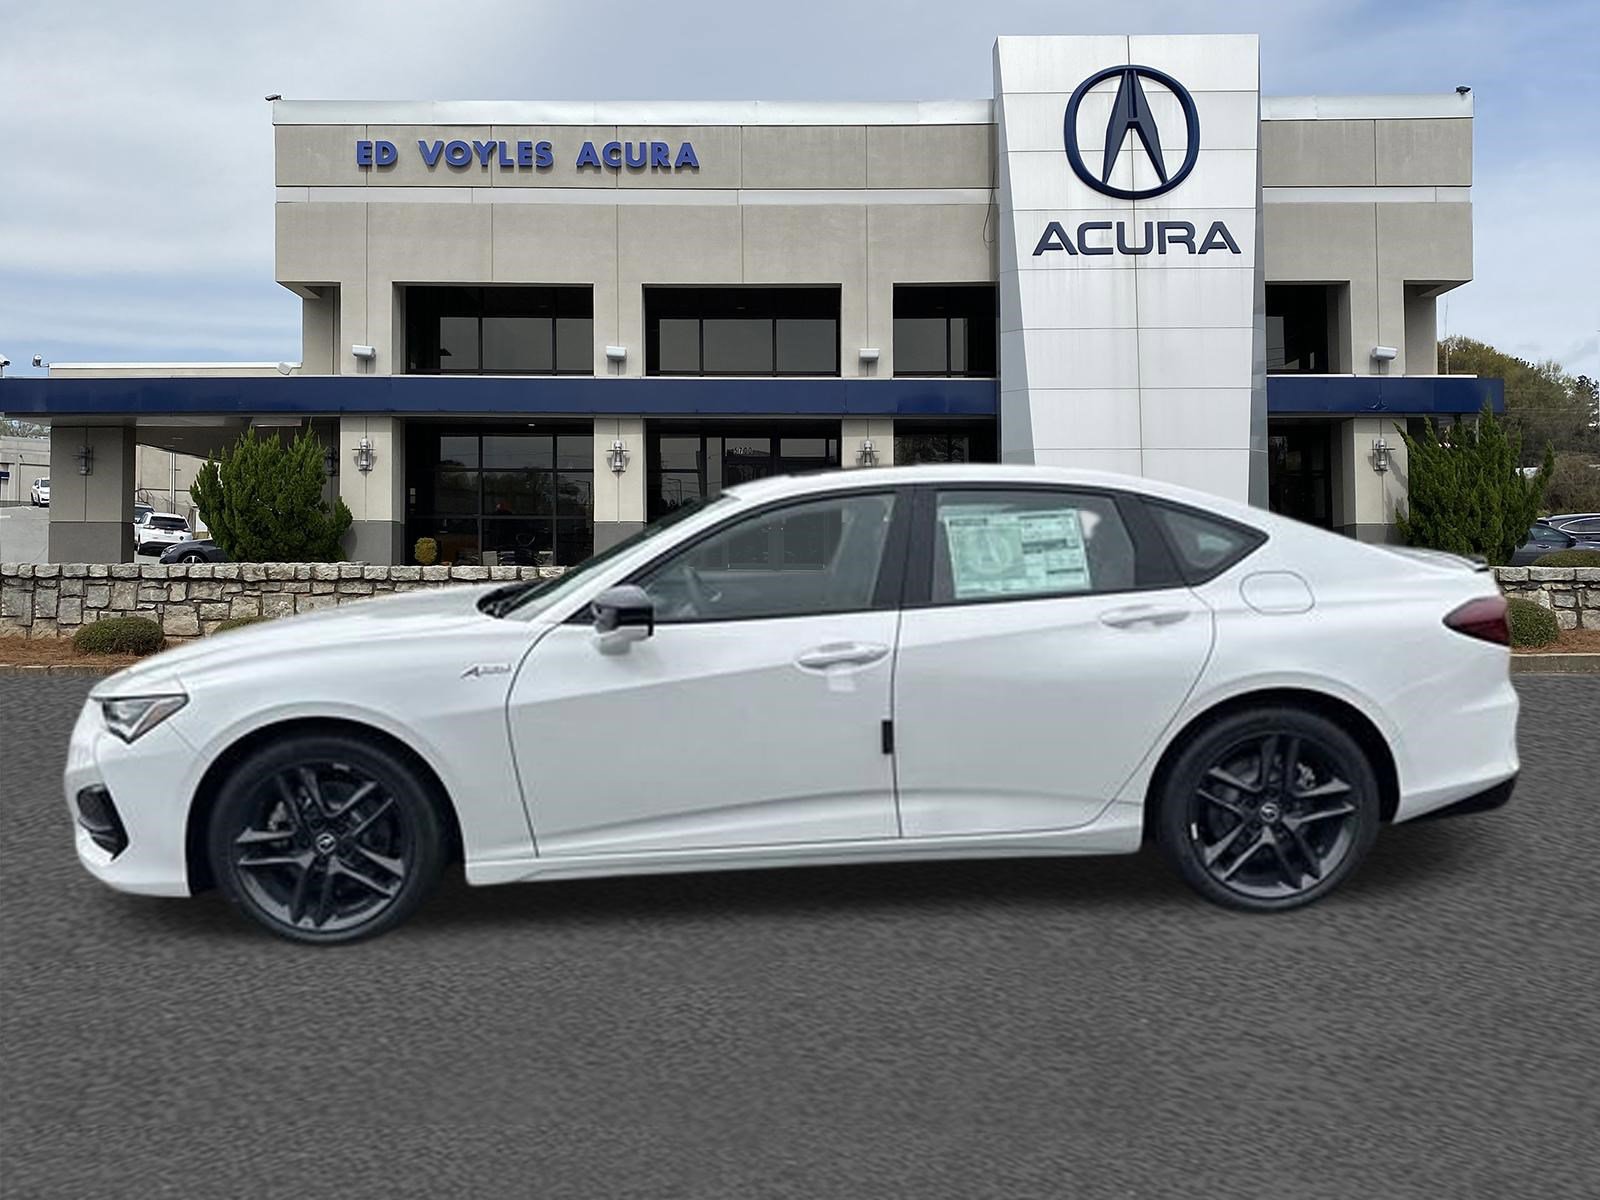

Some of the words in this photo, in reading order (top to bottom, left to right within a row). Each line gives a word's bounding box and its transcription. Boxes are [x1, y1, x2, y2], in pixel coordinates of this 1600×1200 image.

[356, 141, 398, 167] ED
[418, 141, 553, 168] VOYLES
[576, 141, 700, 169] ACURA
[1032, 221, 1242, 256] ACURA
